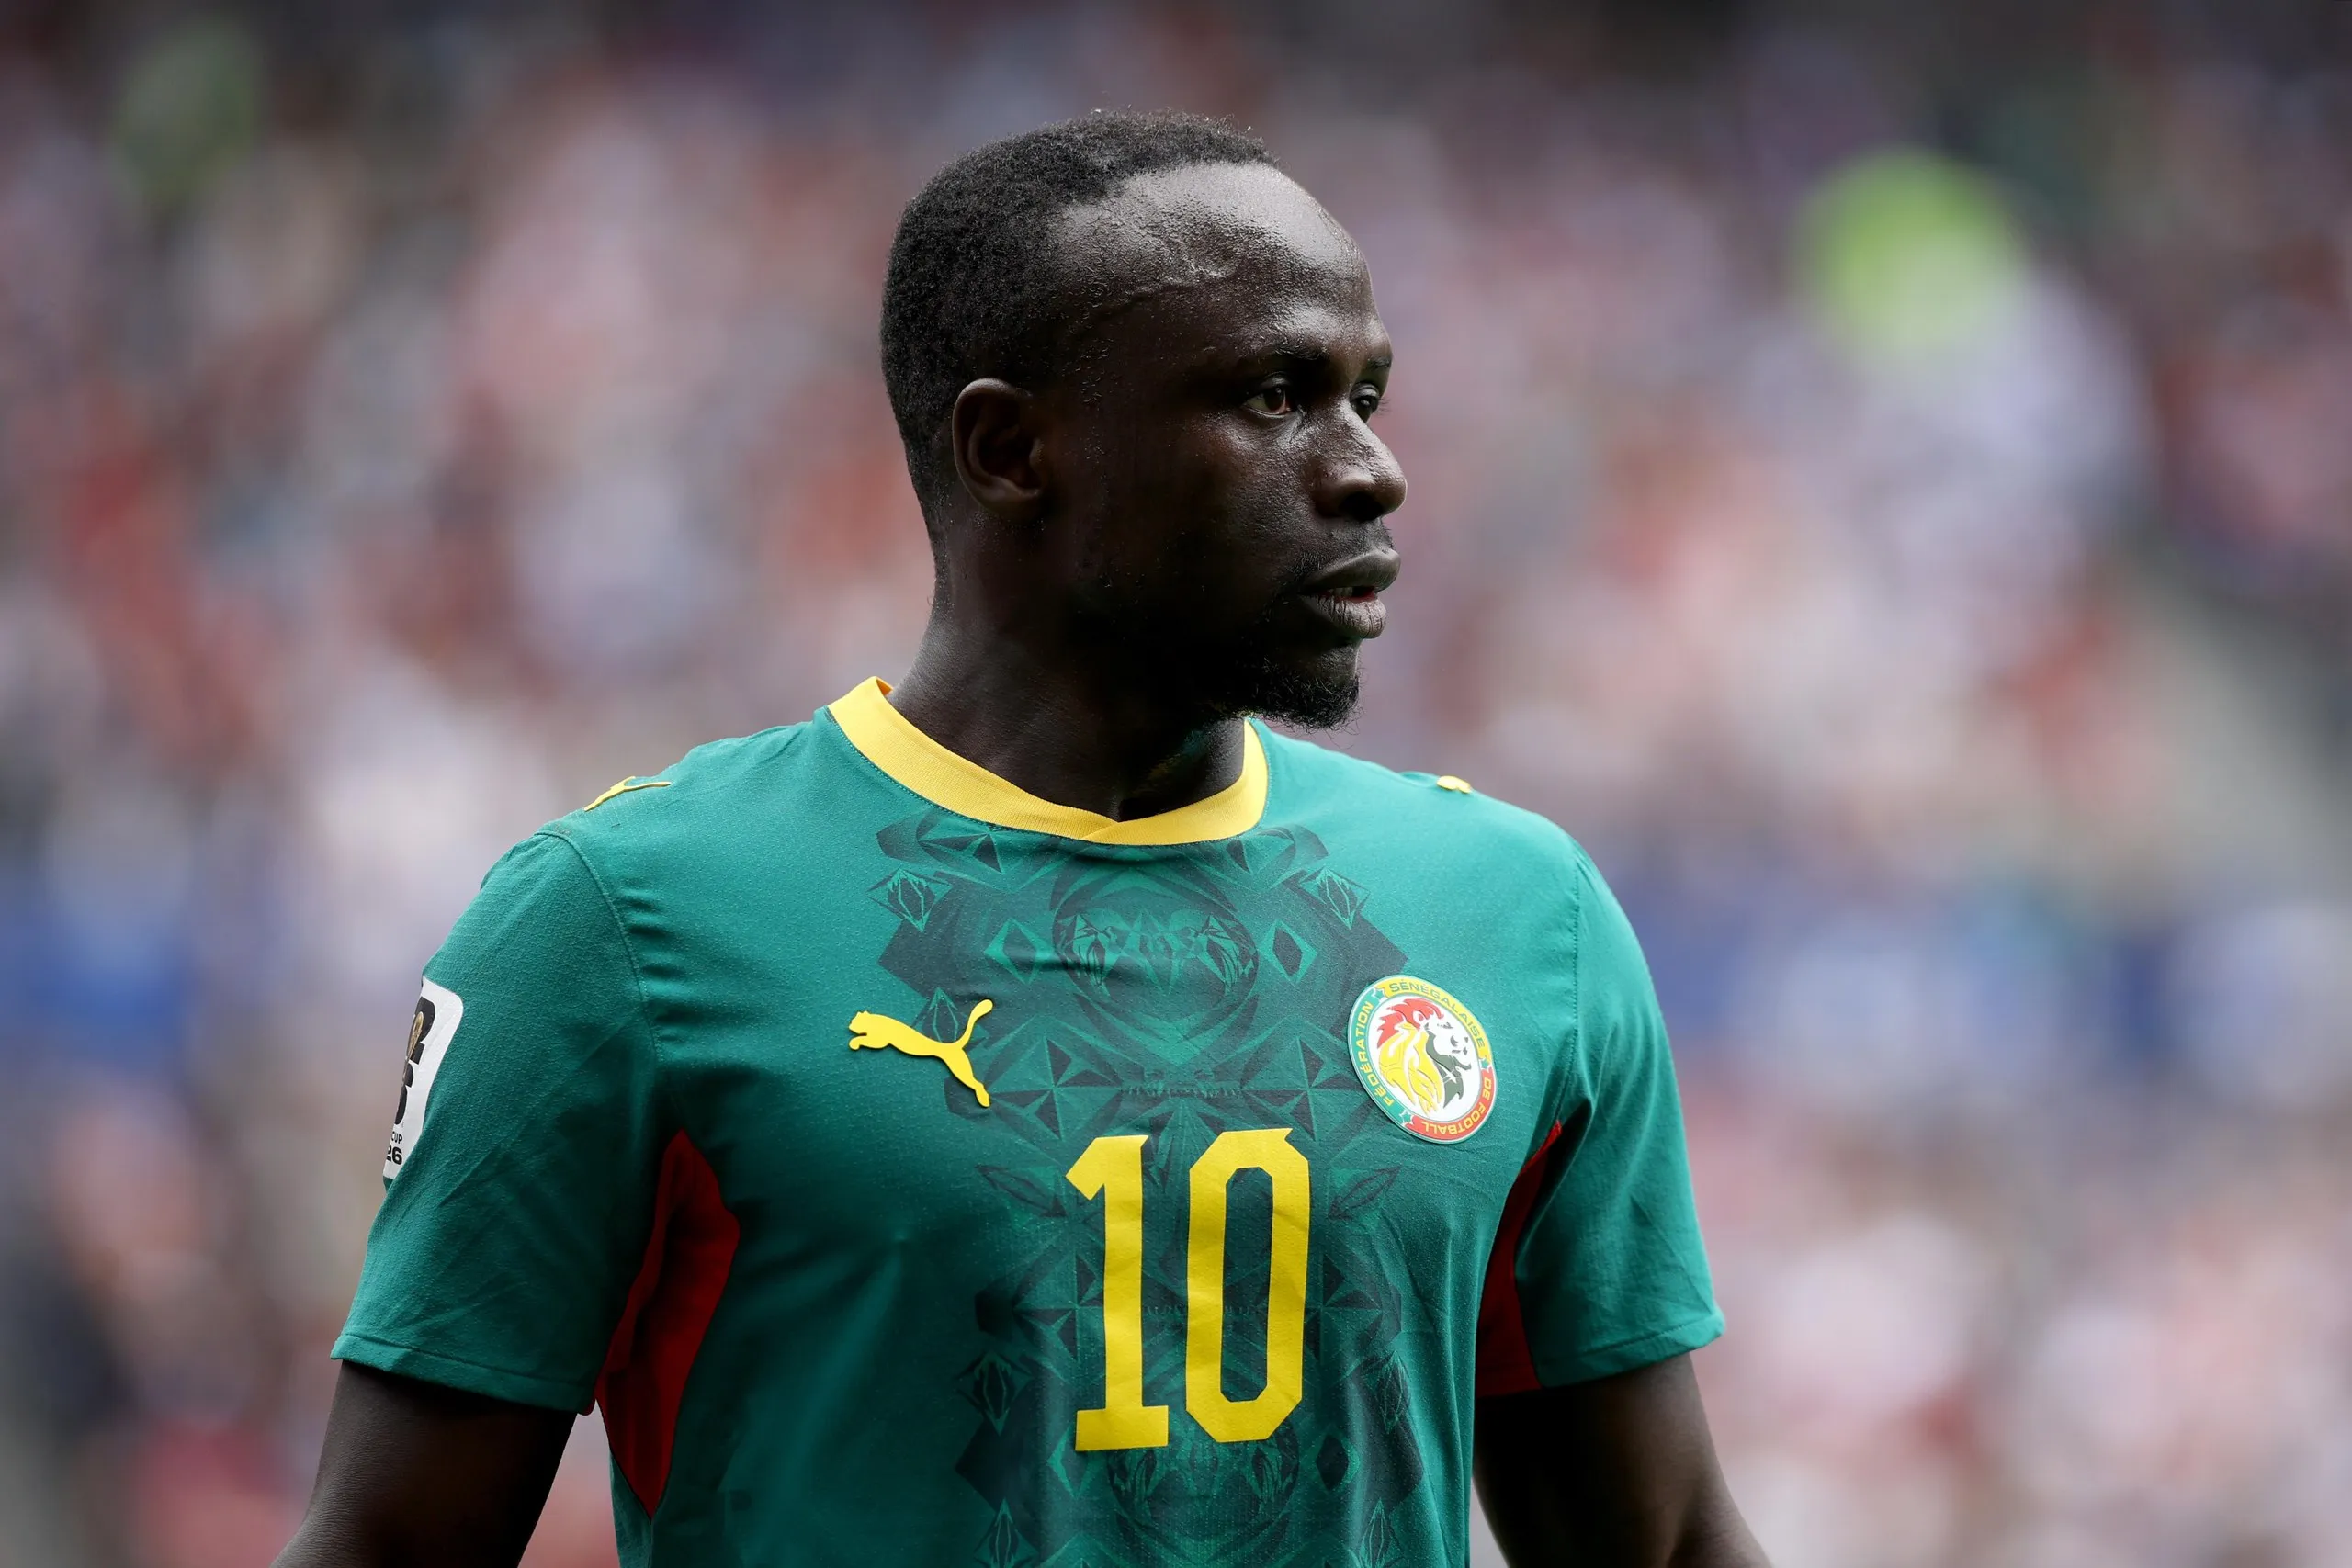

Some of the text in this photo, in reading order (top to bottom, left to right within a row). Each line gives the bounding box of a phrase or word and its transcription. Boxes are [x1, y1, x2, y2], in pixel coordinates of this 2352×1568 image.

[1355, 979, 1492, 1135] FÉDÉRATION SÉNÉGALAISE DE FOOTBALL
[1065, 1128, 1311, 1451] 10
